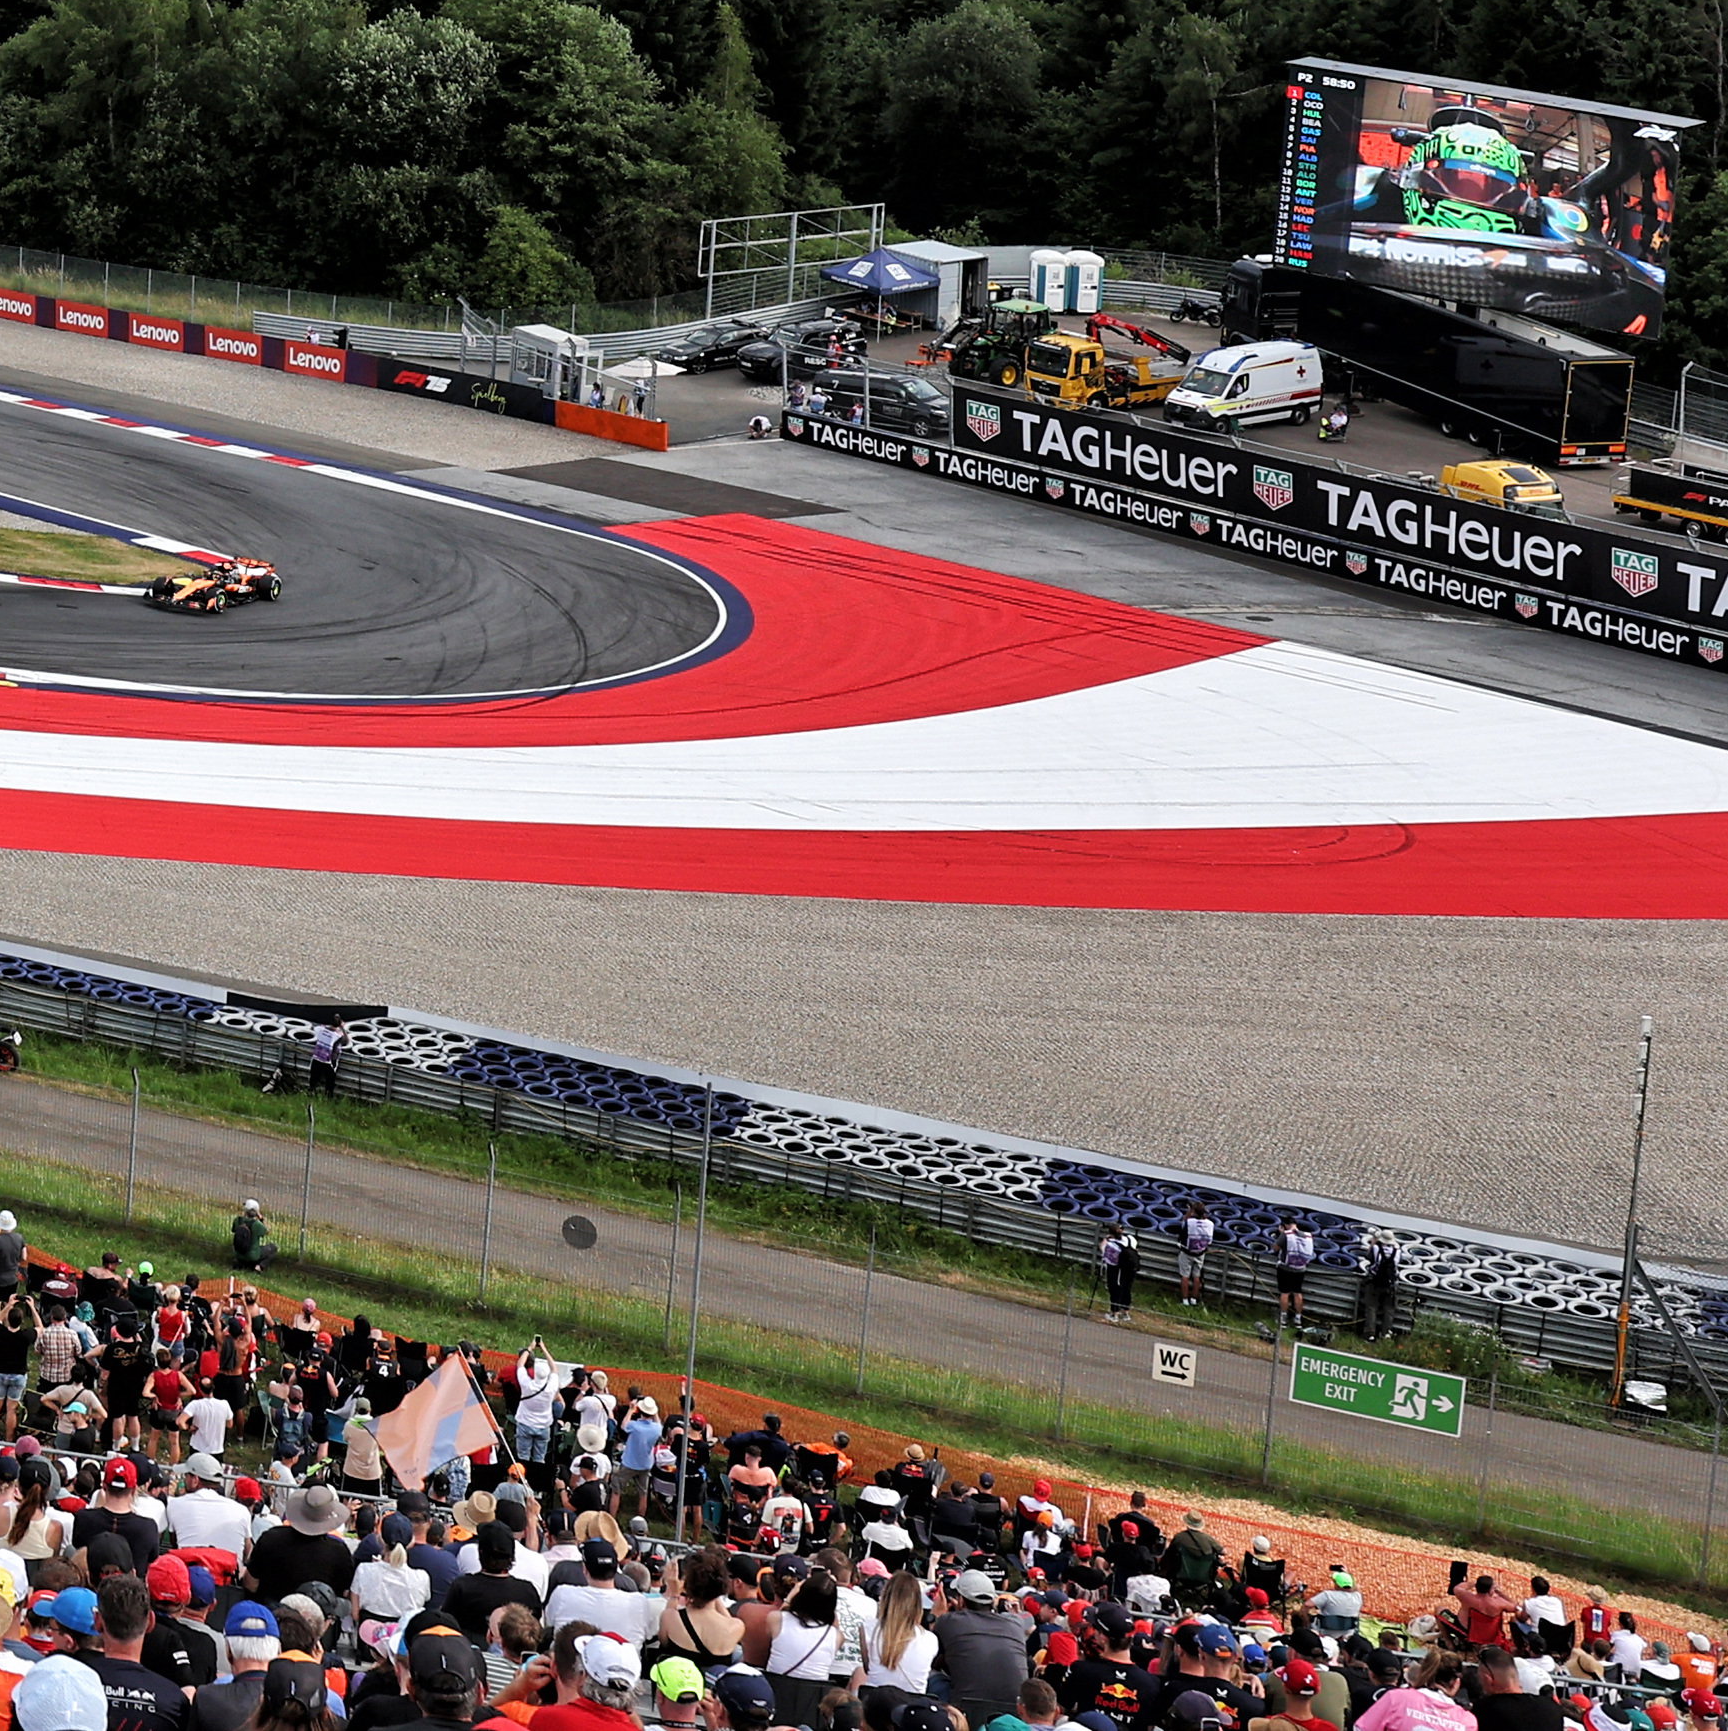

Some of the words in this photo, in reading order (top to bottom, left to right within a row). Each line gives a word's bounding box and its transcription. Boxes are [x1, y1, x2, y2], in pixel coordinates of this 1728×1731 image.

[1298, 73, 1313, 83] P2
[1323, 76, 1356, 89] 58:50
[1305, 92, 1323, 101] COL
[1303, 100, 1323, 110] OCO
[1303, 109, 1322, 118] HUL
[1301, 118, 1321, 127] BEA
[1301, 127, 1321, 136] GAS
[1301, 136, 1317, 144] SAI
[1299, 144, 1316, 153] PIA
[1299, 154, 1317, 162] ALB
[1298, 162, 1317, 170] STR
[1297, 171, 1317, 180] ALO
[1296, 179, 1316, 188] BOR
[1295, 188, 1317, 198] ANT
[1295, 196, 1313, 206] VER
[1293, 206, 1315, 215] NOR
[1293, 214, 1314, 224] HAD
[1291, 232, 1310, 240] TSU
[1290, 240, 1313, 250] LAW
[1288, 258, 1308, 268] RUS
[60, 306, 104, 329] Lenovo
[133, 319, 179, 343] Lenovo
[209, 333, 257, 357] Lenovo
[289, 347, 340, 373] Lenovo
[804, 357, 827, 366] RESC
[471, 381, 507, 415] Spielberg
[968, 402, 1000, 419] TAG
[968, 417, 1000, 440] HEUER
[1255, 466, 1292, 486] TAG
[1255, 483, 1292, 509] HEUER
[1614, 550, 1657, 572] TAG
[1614, 568, 1657, 596] HEUER
[1160, 1349, 1190, 1370] WC
[379, 1365, 389, 1377] 4
[1301, 1357, 1385, 1387] EMERGENCY
[1325, 1383, 1358, 1402] EXIT
[105, 1684, 125, 1697] Bull
[112, 1701, 156, 1714] CING
